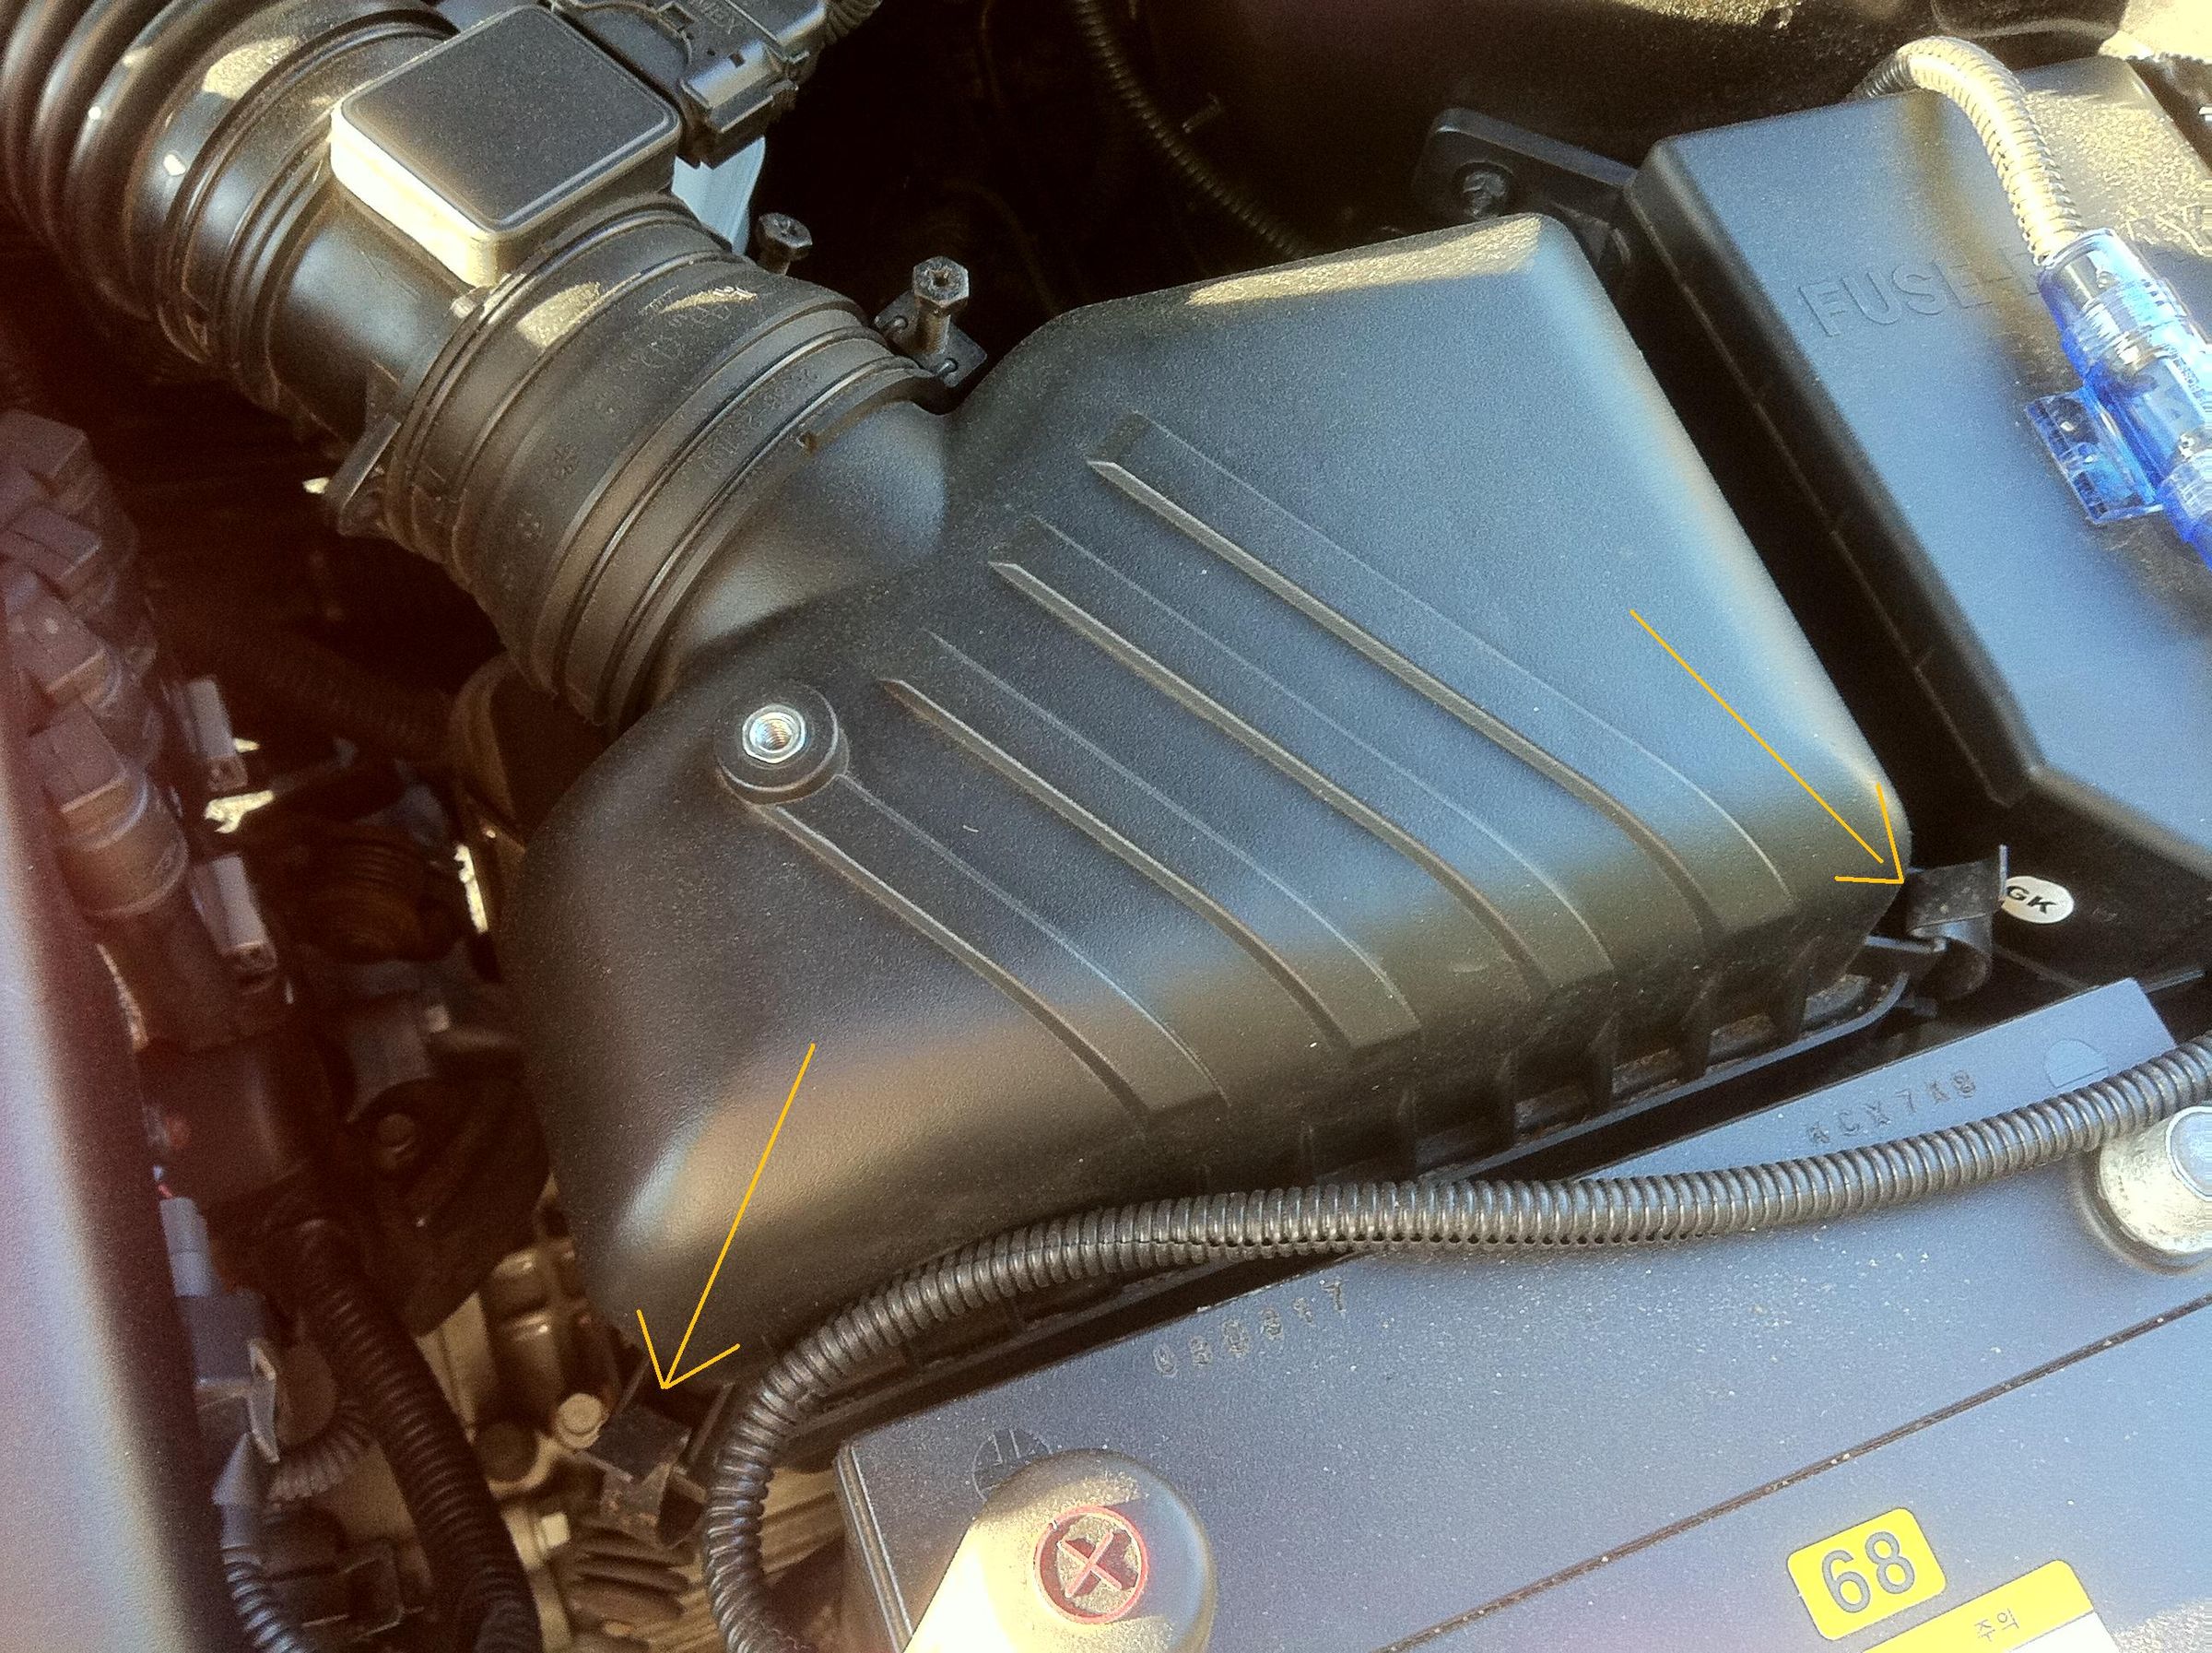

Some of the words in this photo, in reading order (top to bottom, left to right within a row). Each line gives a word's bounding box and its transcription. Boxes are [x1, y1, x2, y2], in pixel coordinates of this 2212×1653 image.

[2006, 885, 2057, 914] GK
[1821, 1531, 1915, 1613] 68
[1974, 1608, 2019, 1642] 주의
